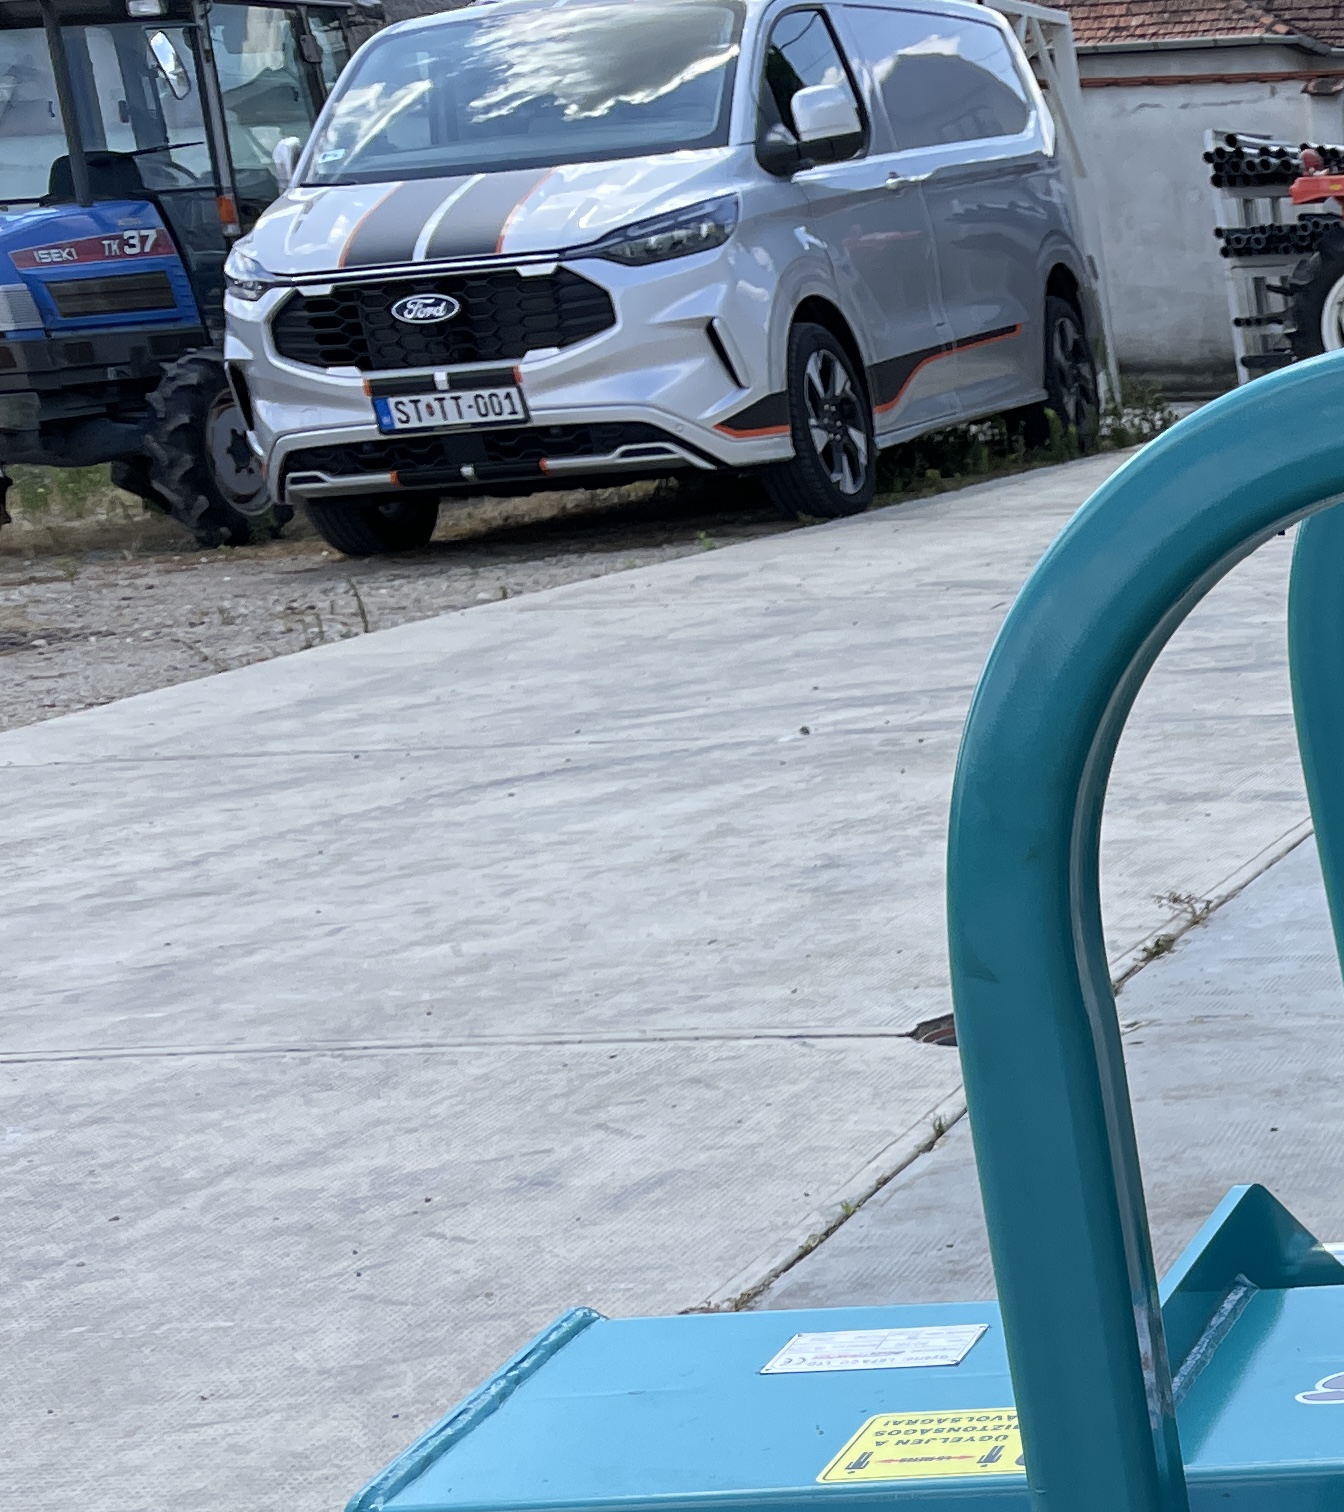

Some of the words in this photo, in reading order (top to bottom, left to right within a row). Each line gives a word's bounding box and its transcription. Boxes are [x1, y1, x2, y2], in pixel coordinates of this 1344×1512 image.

[33, 247, 79, 263] ISEKI
[402, 297, 448, 320] Ford
[394, 398, 423, 425] ST
[875, 1439, 889, 1447] A
[894, 1434, 1009, 1446] ÜGYELJEN
